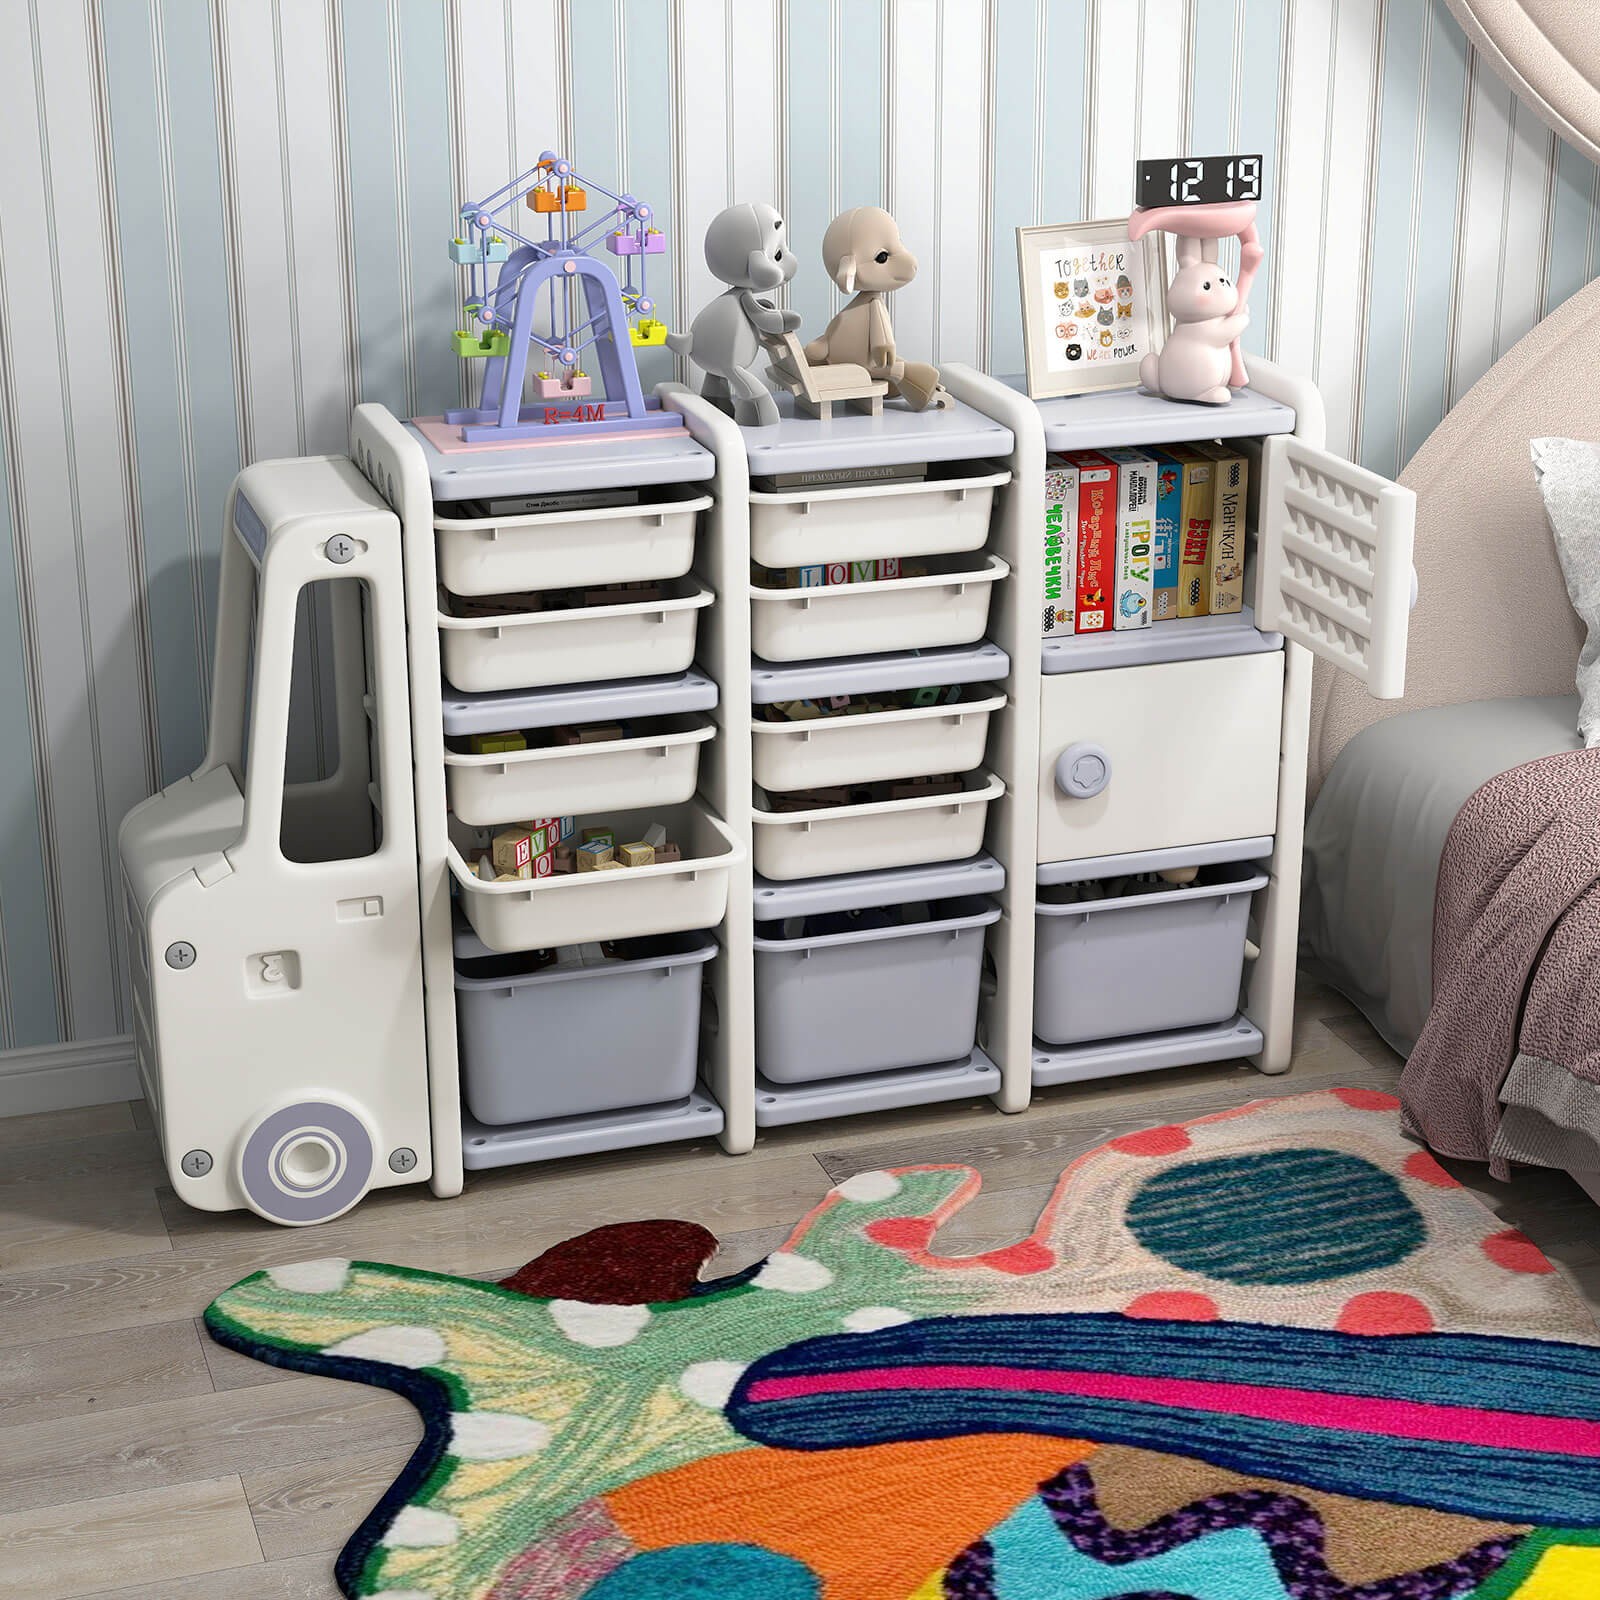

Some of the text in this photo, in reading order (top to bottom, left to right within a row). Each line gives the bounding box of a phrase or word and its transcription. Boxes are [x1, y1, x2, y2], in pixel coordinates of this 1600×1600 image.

[1170, 158, 1260, 201] 12 19
[1045, 503, 1064, 600] ЧЕЛОВЕЧКИ
[1130, 519, 1151, 582] ГРОГУ
[1221, 493, 1239, 560] Манчкин
